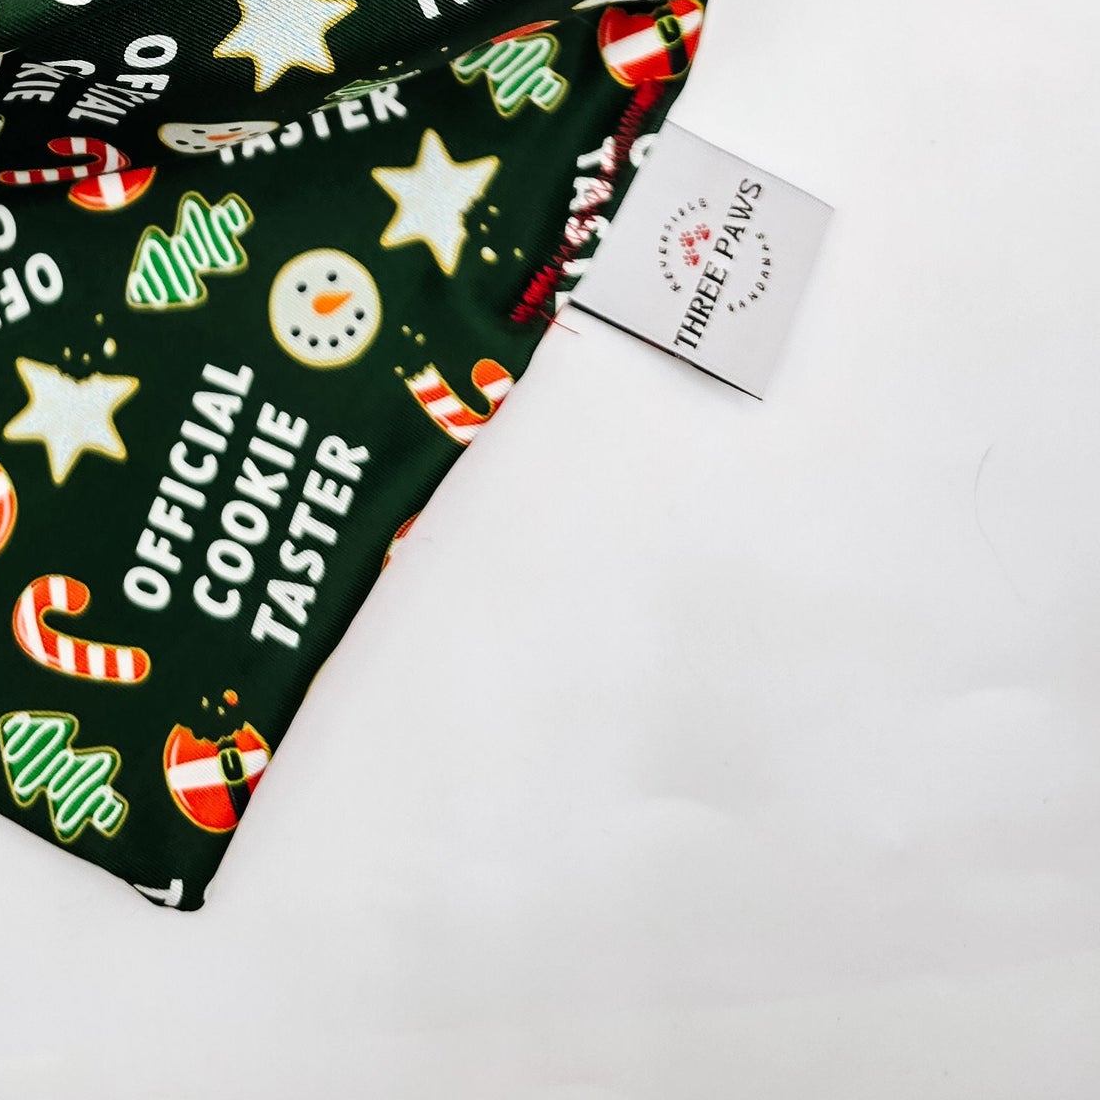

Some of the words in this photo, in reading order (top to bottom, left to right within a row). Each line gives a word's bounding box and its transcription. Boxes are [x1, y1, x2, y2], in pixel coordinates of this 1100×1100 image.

[674, 261, 728, 350] THREE
[712, 177, 763, 260] PAWS
[123, 364, 254, 611] OFFICIAL
[193, 402, 309, 619] COOKIE
[251, 434, 370, 649] TASTER
